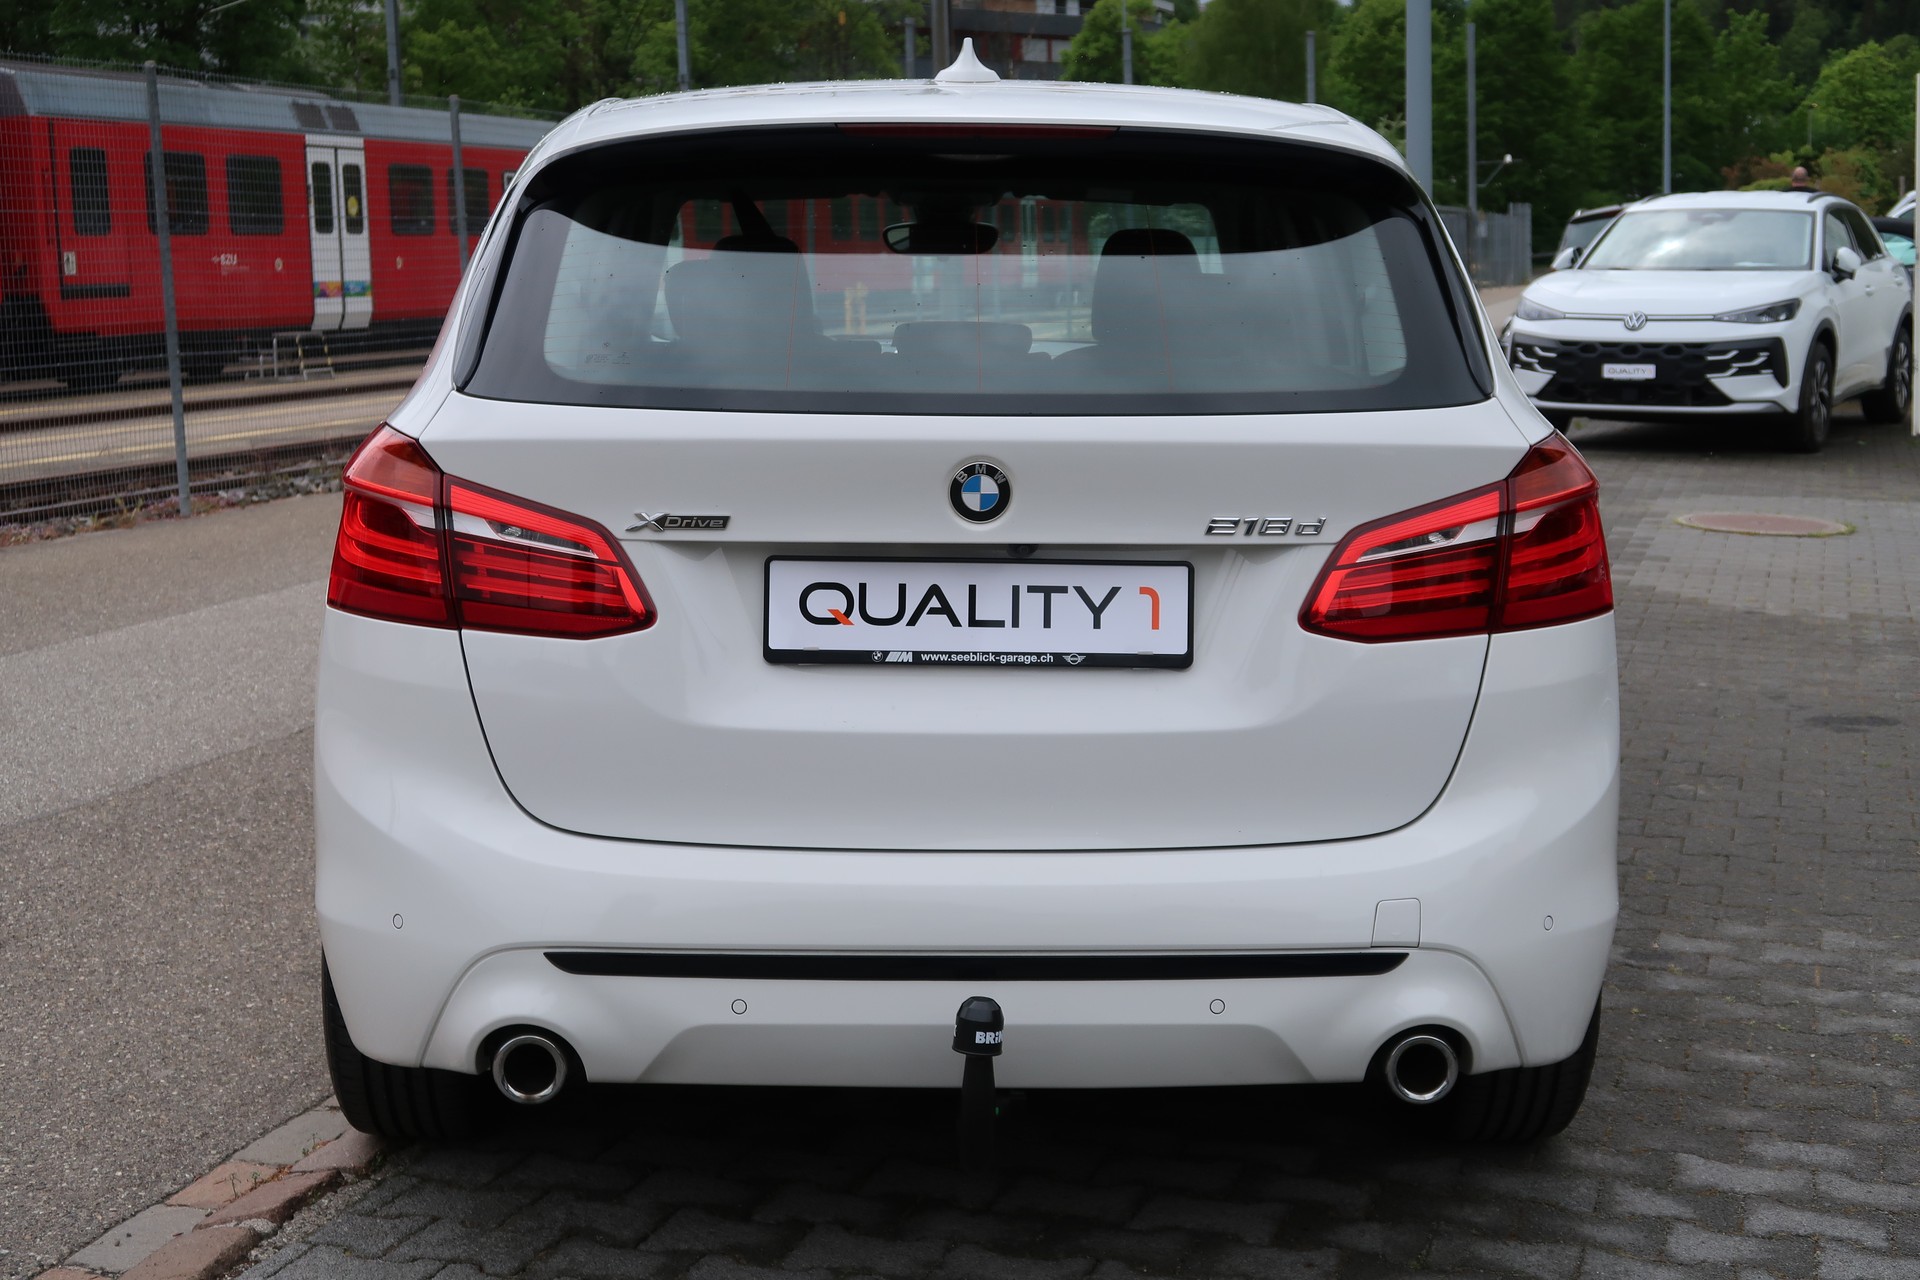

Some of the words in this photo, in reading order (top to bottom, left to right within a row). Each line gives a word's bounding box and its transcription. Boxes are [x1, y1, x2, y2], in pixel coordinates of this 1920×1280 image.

[955, 464, 1007, 484] BMW
[799, 582, 1122, 630] QUALITY
[1139, 586, 1160, 630] 1
[921, 652, 1054, 665] www.seeblick-garage.ch
